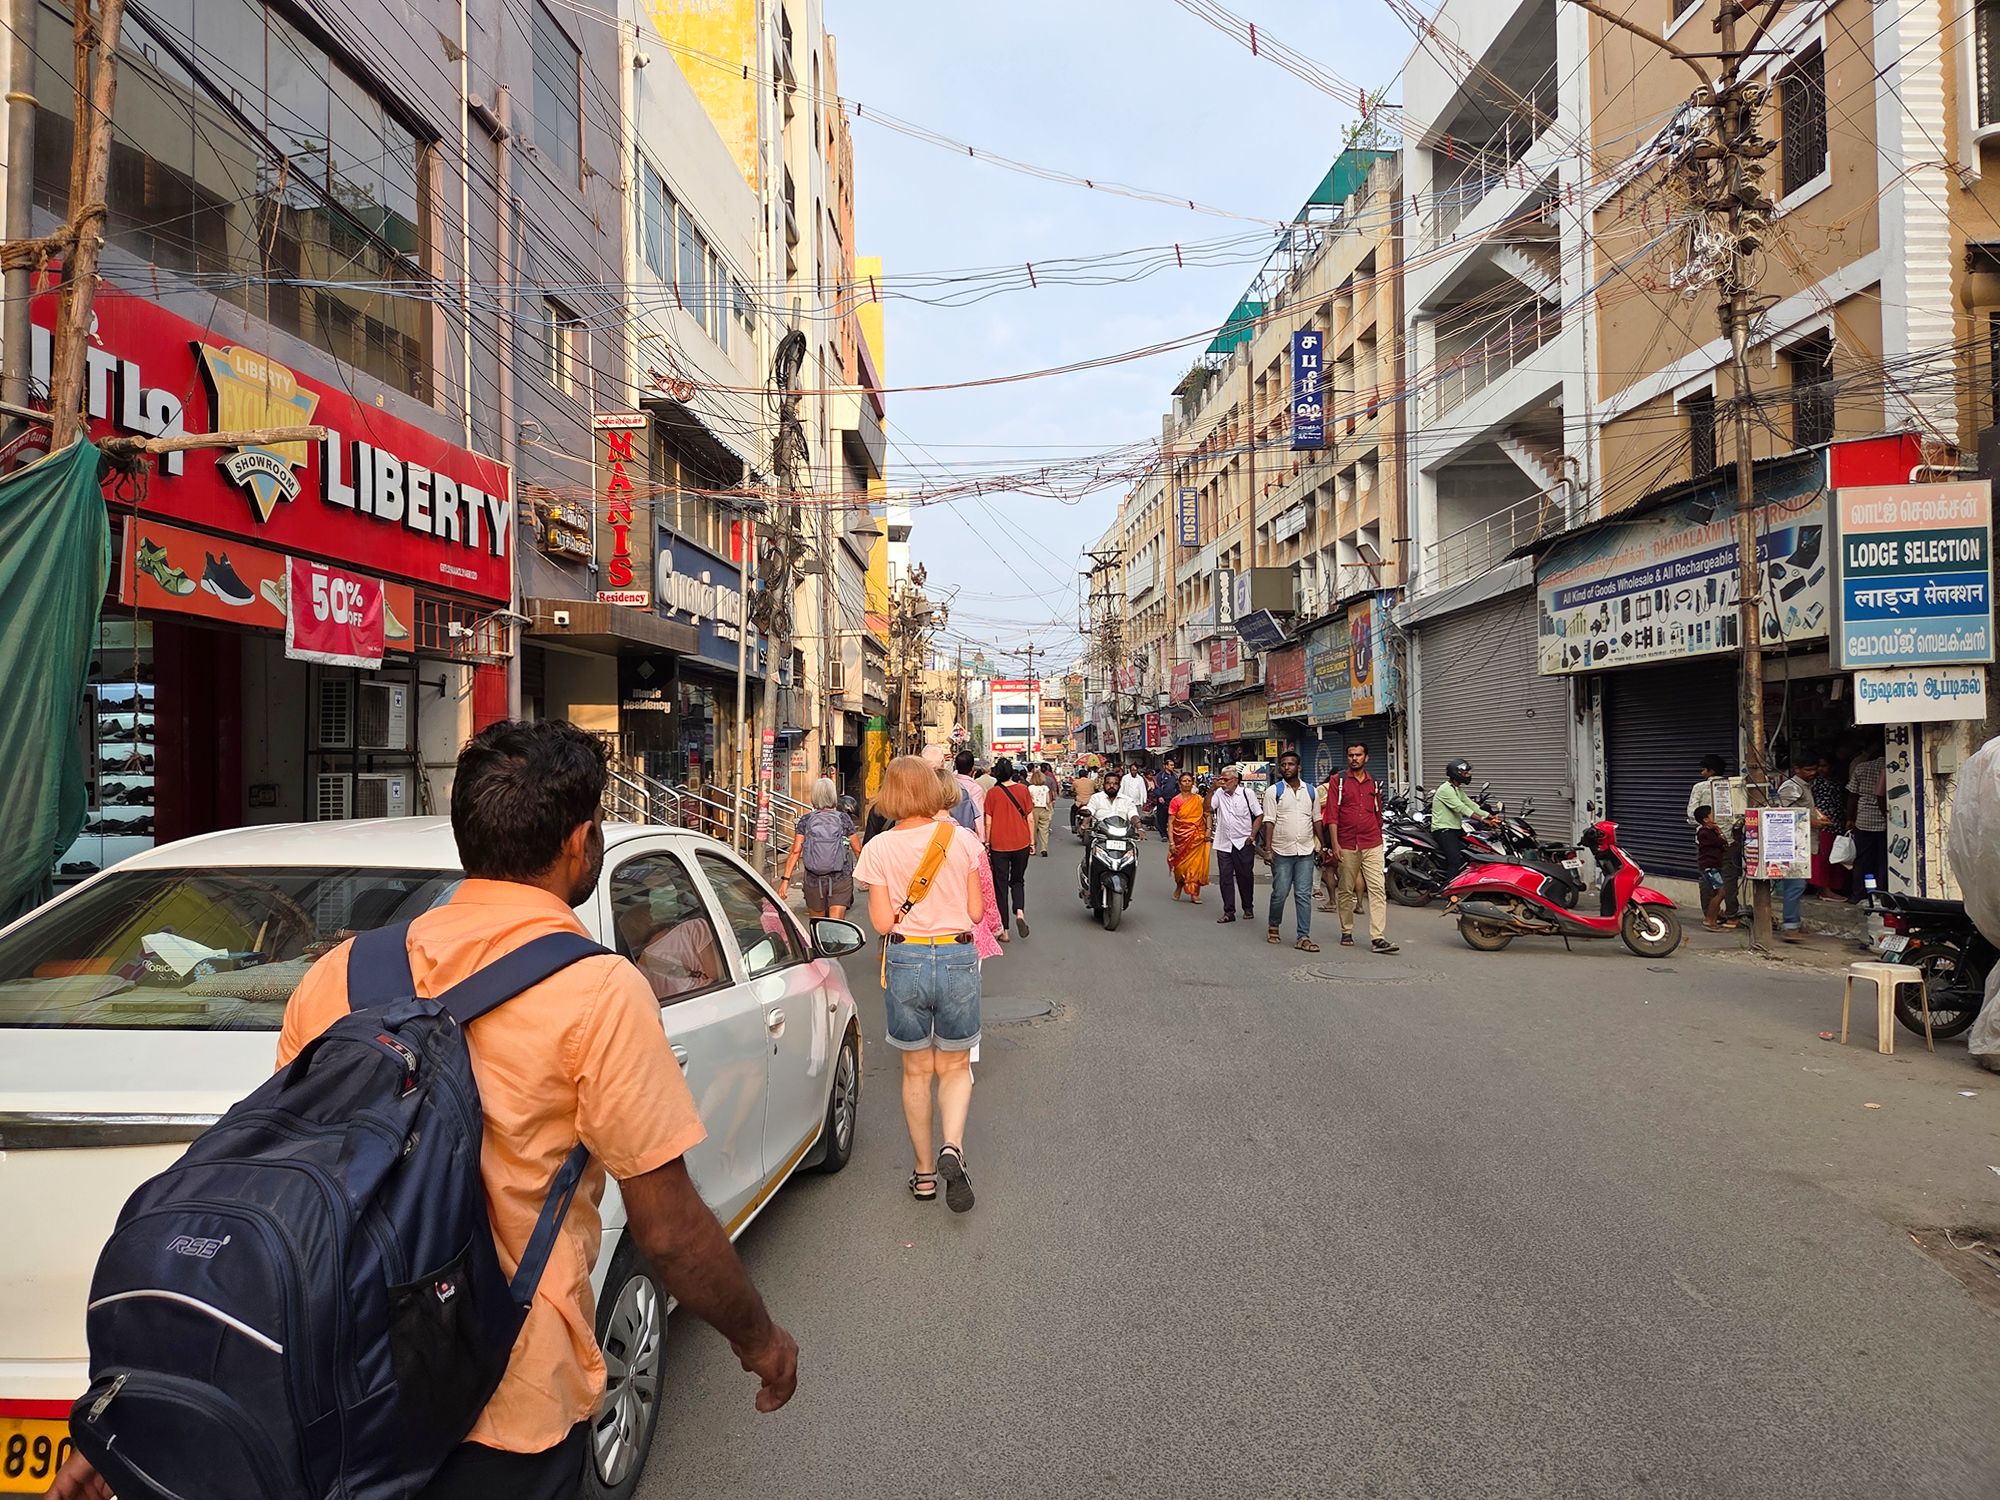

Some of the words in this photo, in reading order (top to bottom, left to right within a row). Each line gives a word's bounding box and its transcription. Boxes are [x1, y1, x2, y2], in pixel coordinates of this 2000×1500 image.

[236, 356, 292, 393] LIBERTY
[235, 456, 295, 491] SHOWROOM
[327, 427, 511, 557] LIBERTY
[607, 431, 634, 586] MANIS
[1851, 496, 1897, 525] லாட்ஜ்
[1900, 491, 1978, 522] செலக்சன்
[1184, 492, 1196, 542] ROSHAN
[1653, 519, 1725, 557] DHANALAXMI
[1850, 541, 1898, 568] LODGE
[1904, 538, 1980, 564] SELECTION
[1562, 592, 1571, 605] All
[1572, 588, 1586, 603] Kind
[1587, 586, 1594, 599] of
[1594, 581, 1616, 597] Goods
[1617, 572, 1653, 591] Wholesale
[1655, 568, 1661, 581] &
[1662, 565, 1673, 581] All
[1675, 548, 1733, 577] Rechargeable
[1924, 580, 1984, 605] सेलक्शन
[312, 573, 363, 624] 50%
[599, 592, 646, 604] Residency
[348, 610, 363, 627] OFF
[1859, 672, 1918, 704] நேஷனல்
[1923, 669, 1981, 701] ஆப்டிகல்
[623, 699, 671, 714] Residency
